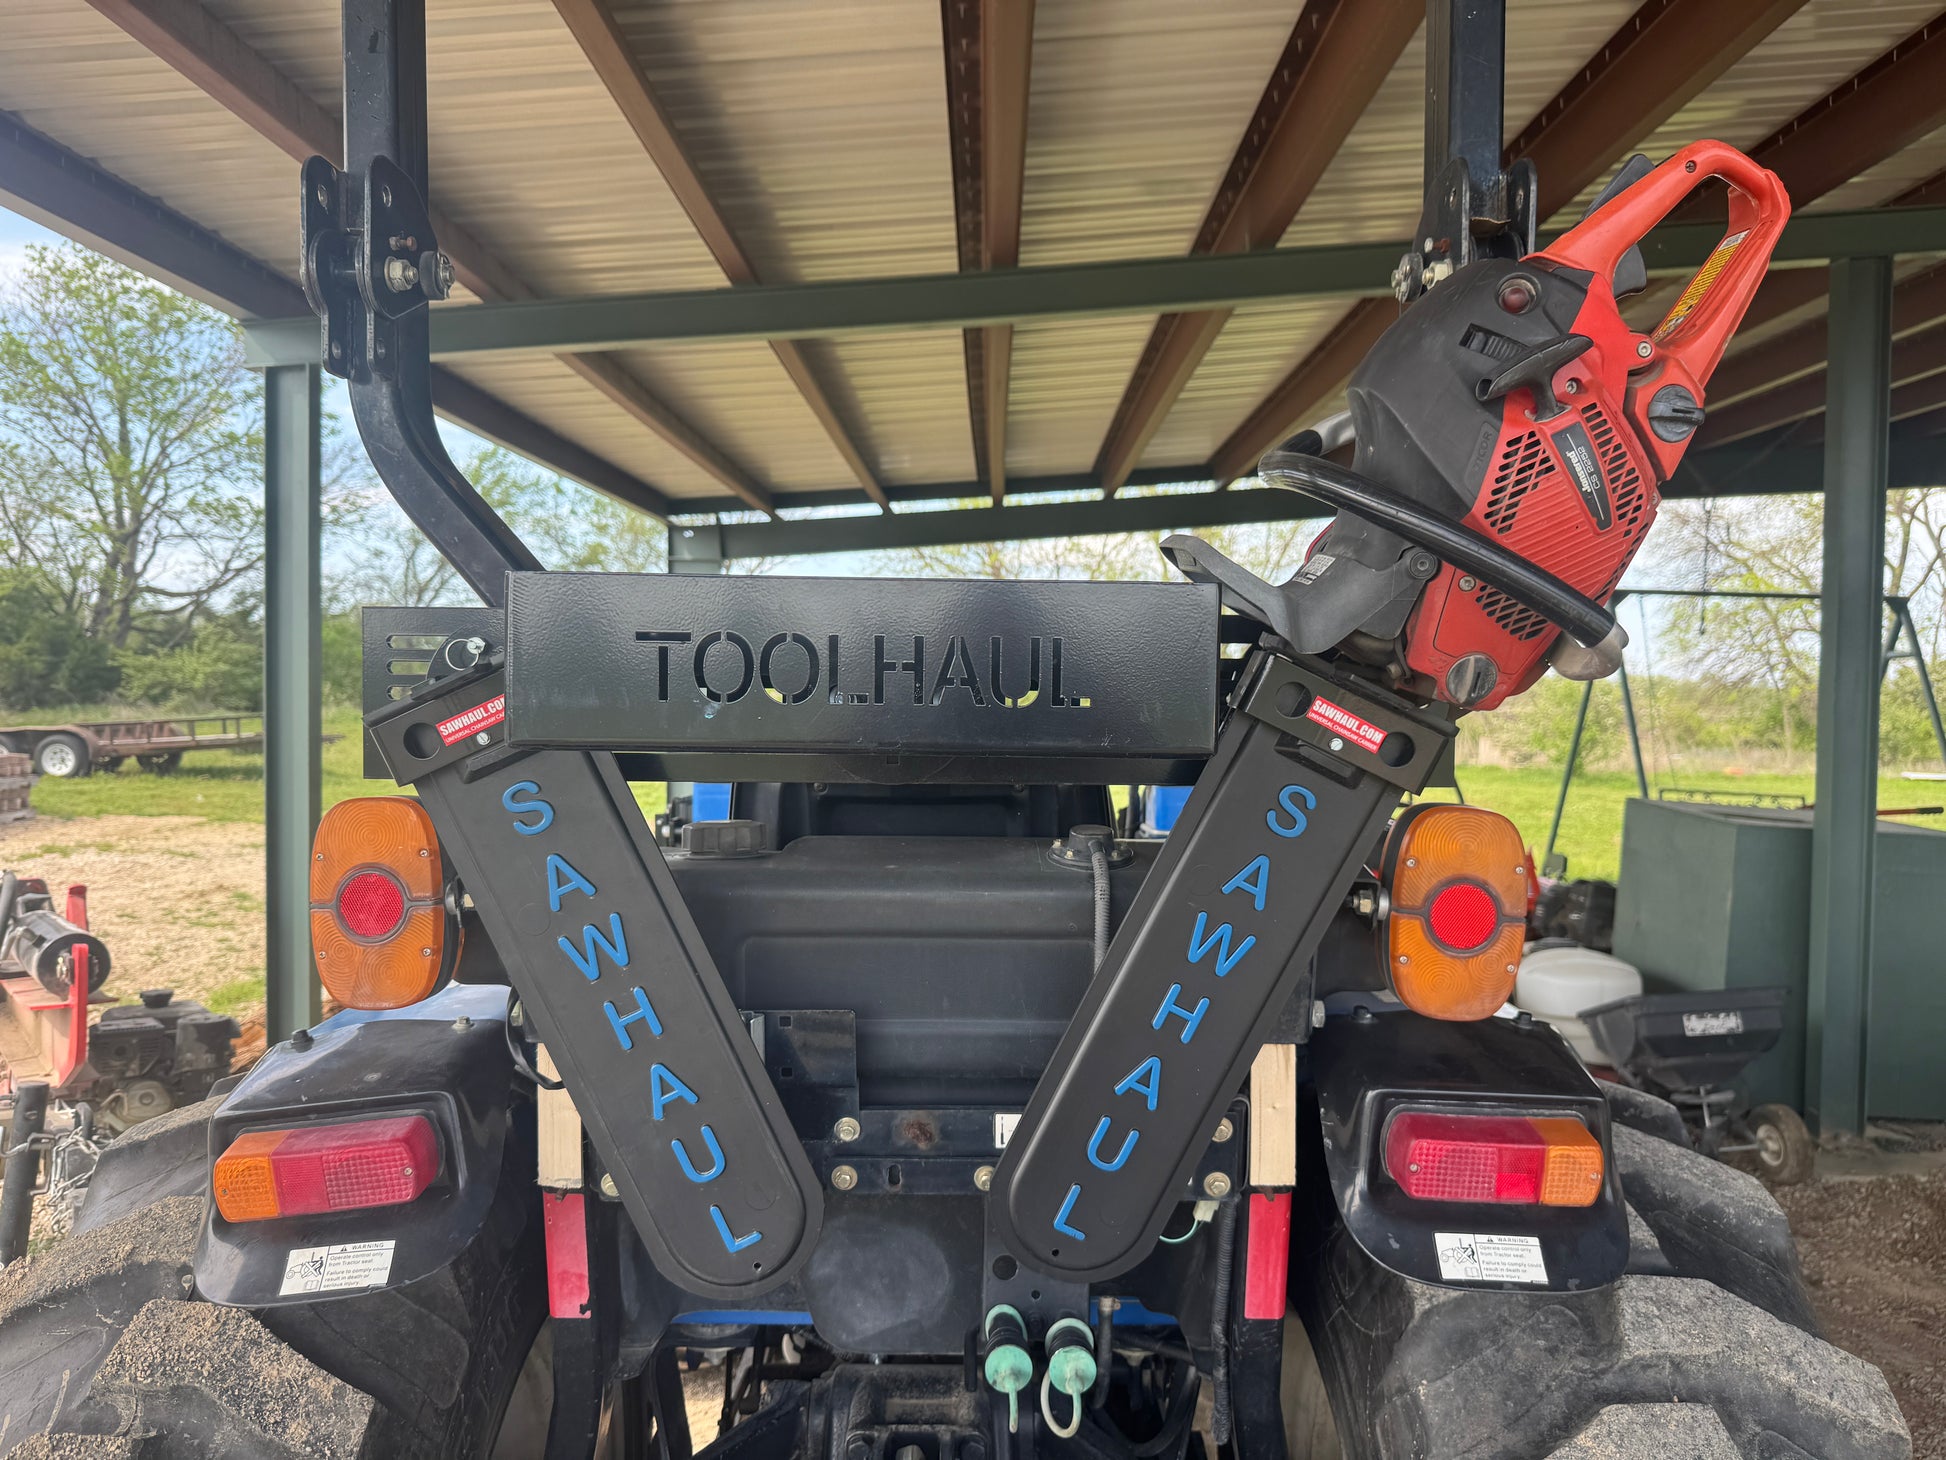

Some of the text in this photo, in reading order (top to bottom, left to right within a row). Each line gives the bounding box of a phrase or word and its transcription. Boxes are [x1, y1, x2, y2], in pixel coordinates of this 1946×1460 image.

[1566, 451, 1591, 493] Jonsered
[1578, 447, 1600, 489] CS 2252
[634, 630, 1092, 709] TOOLHAUL
[446, 716, 496, 743] UNIVERSAL CHAINSAW
[1308, 711, 1377, 751] UNIVERSAL CHAINSAW CARRIER
[1312, 699, 1384, 744] SAWHAUL.COM
[502, 780, 763, 1255] SAWHAUL
[1052, 784, 1317, 1243] SAWHAUL
[330, 1254, 351, 1262] Operate
[352, 1242, 384, 1250] WARNING
